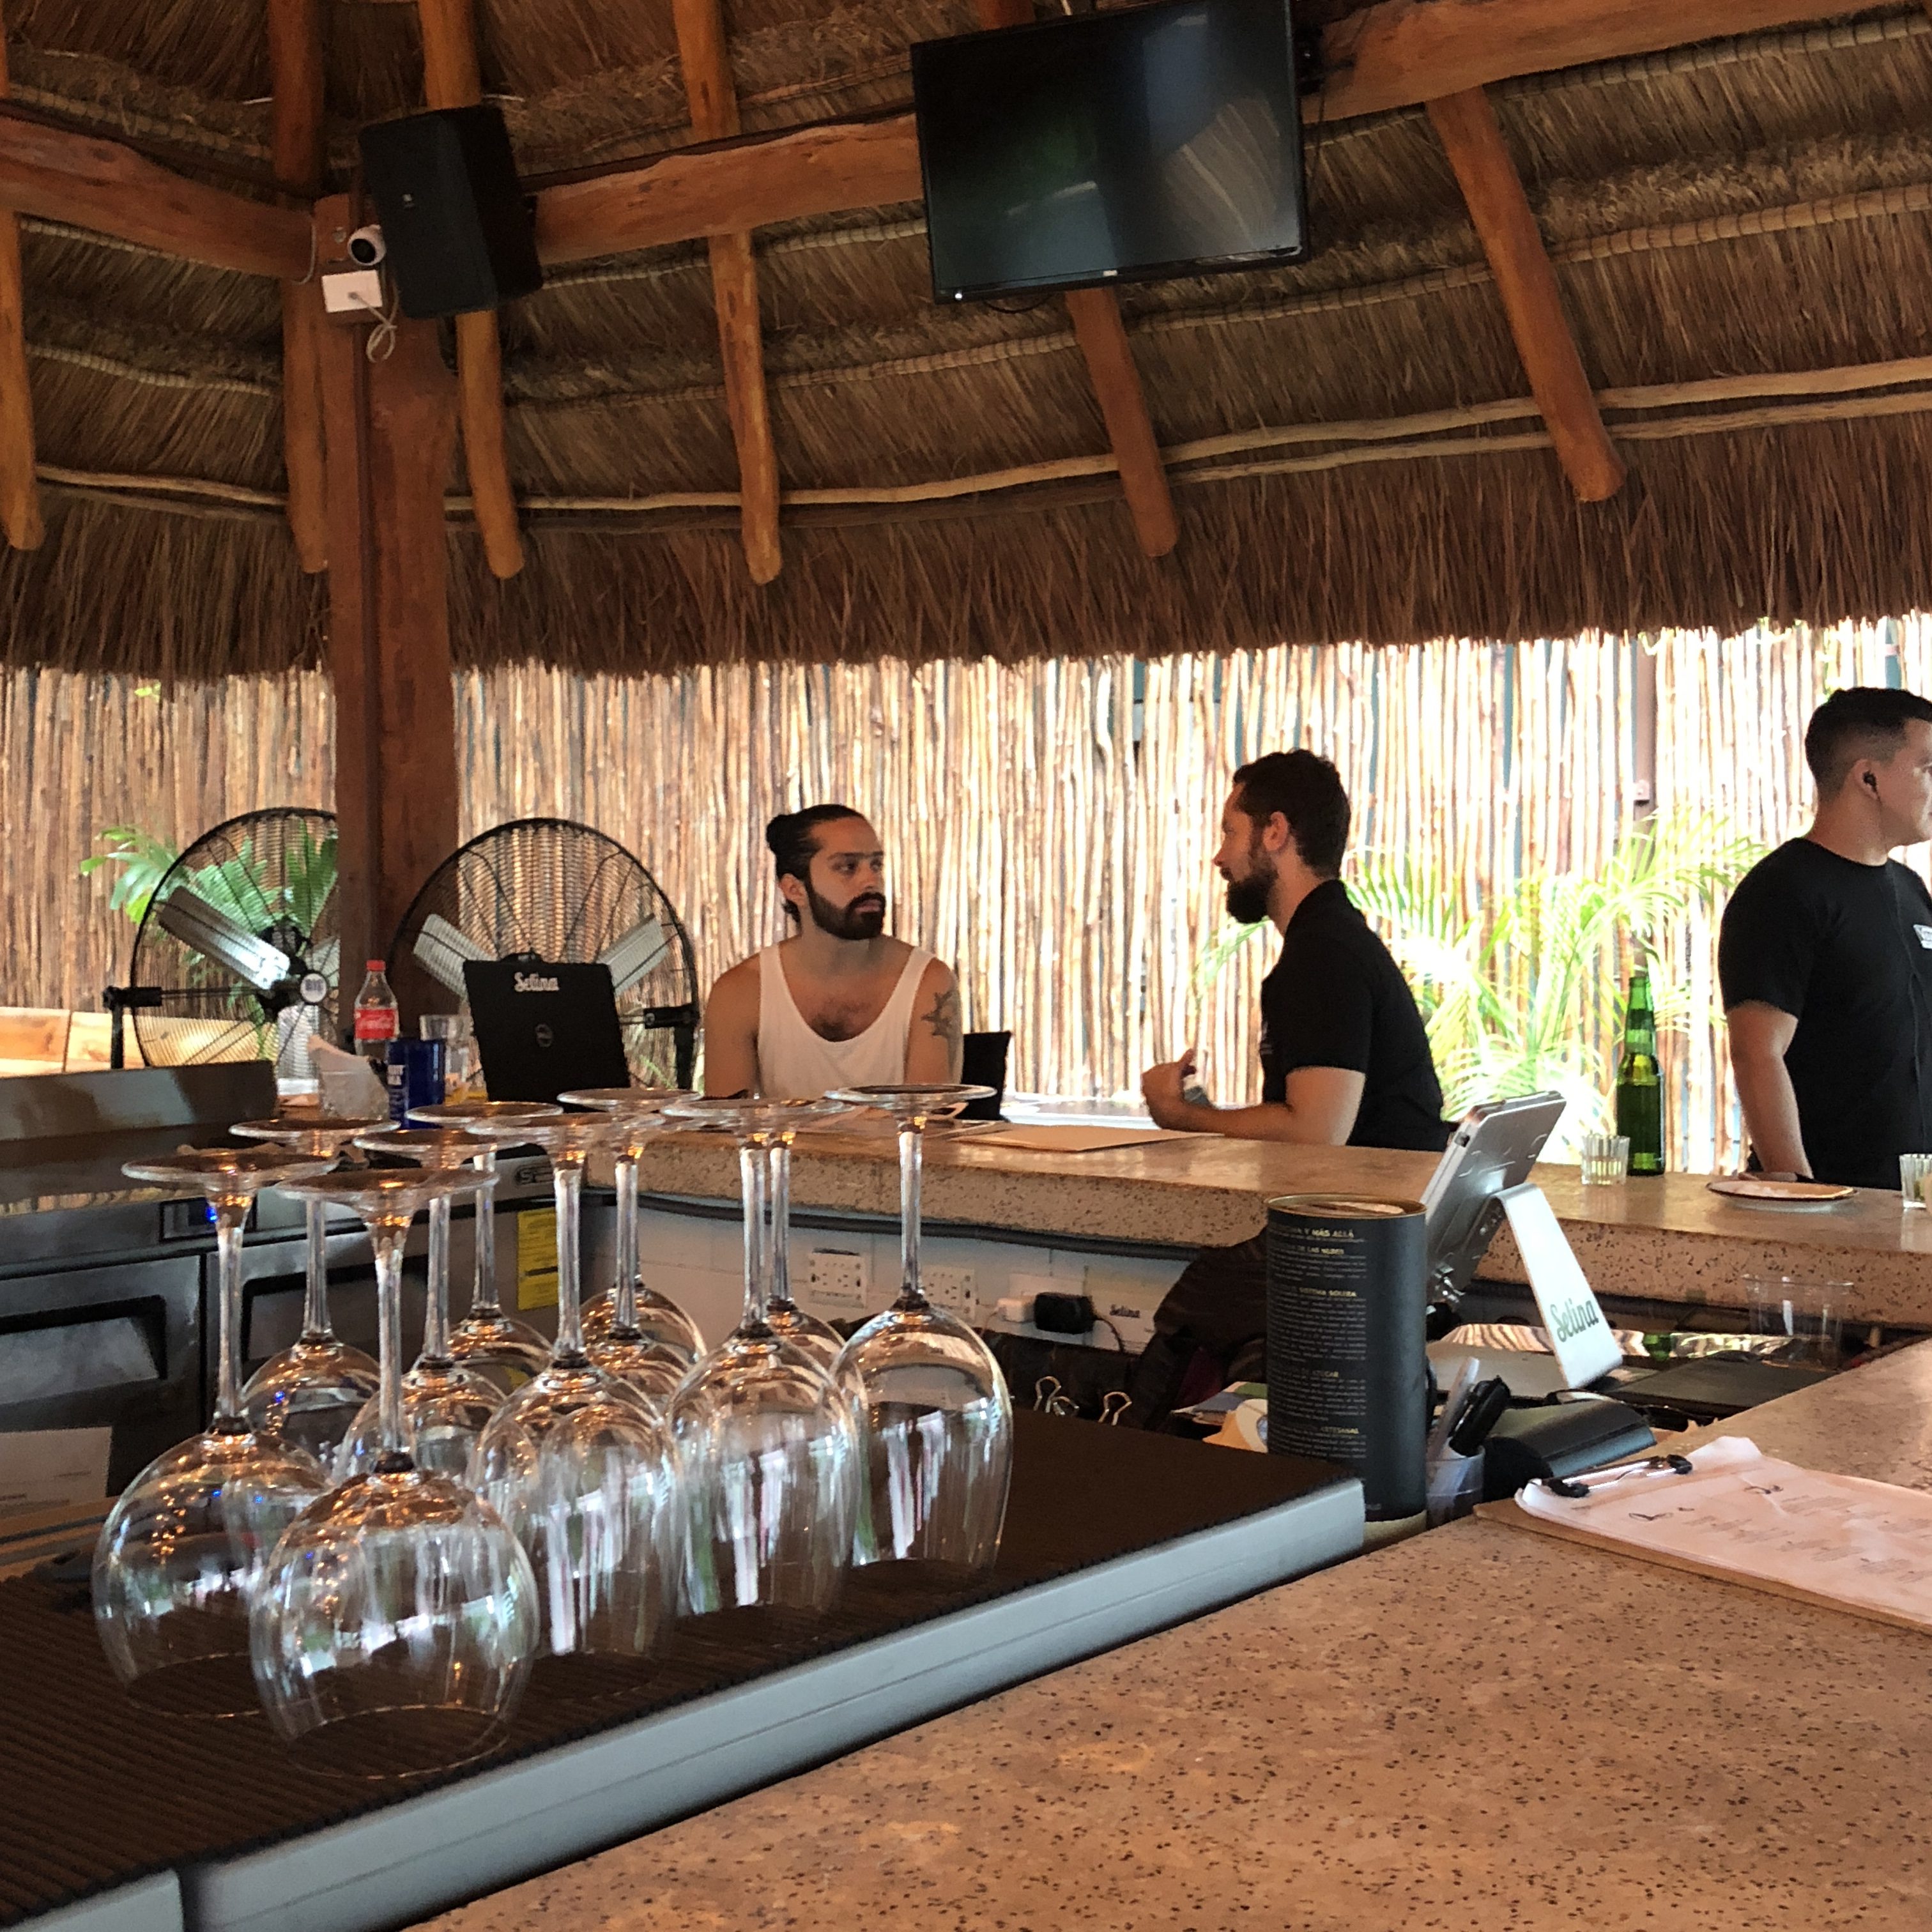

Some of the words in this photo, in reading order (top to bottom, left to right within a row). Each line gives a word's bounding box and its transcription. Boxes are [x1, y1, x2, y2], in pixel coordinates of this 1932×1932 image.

[514, 972, 559, 992] Selina
[1109, 1304, 1140, 1318] Selina
[1550, 1298, 1599, 1342] Selina
